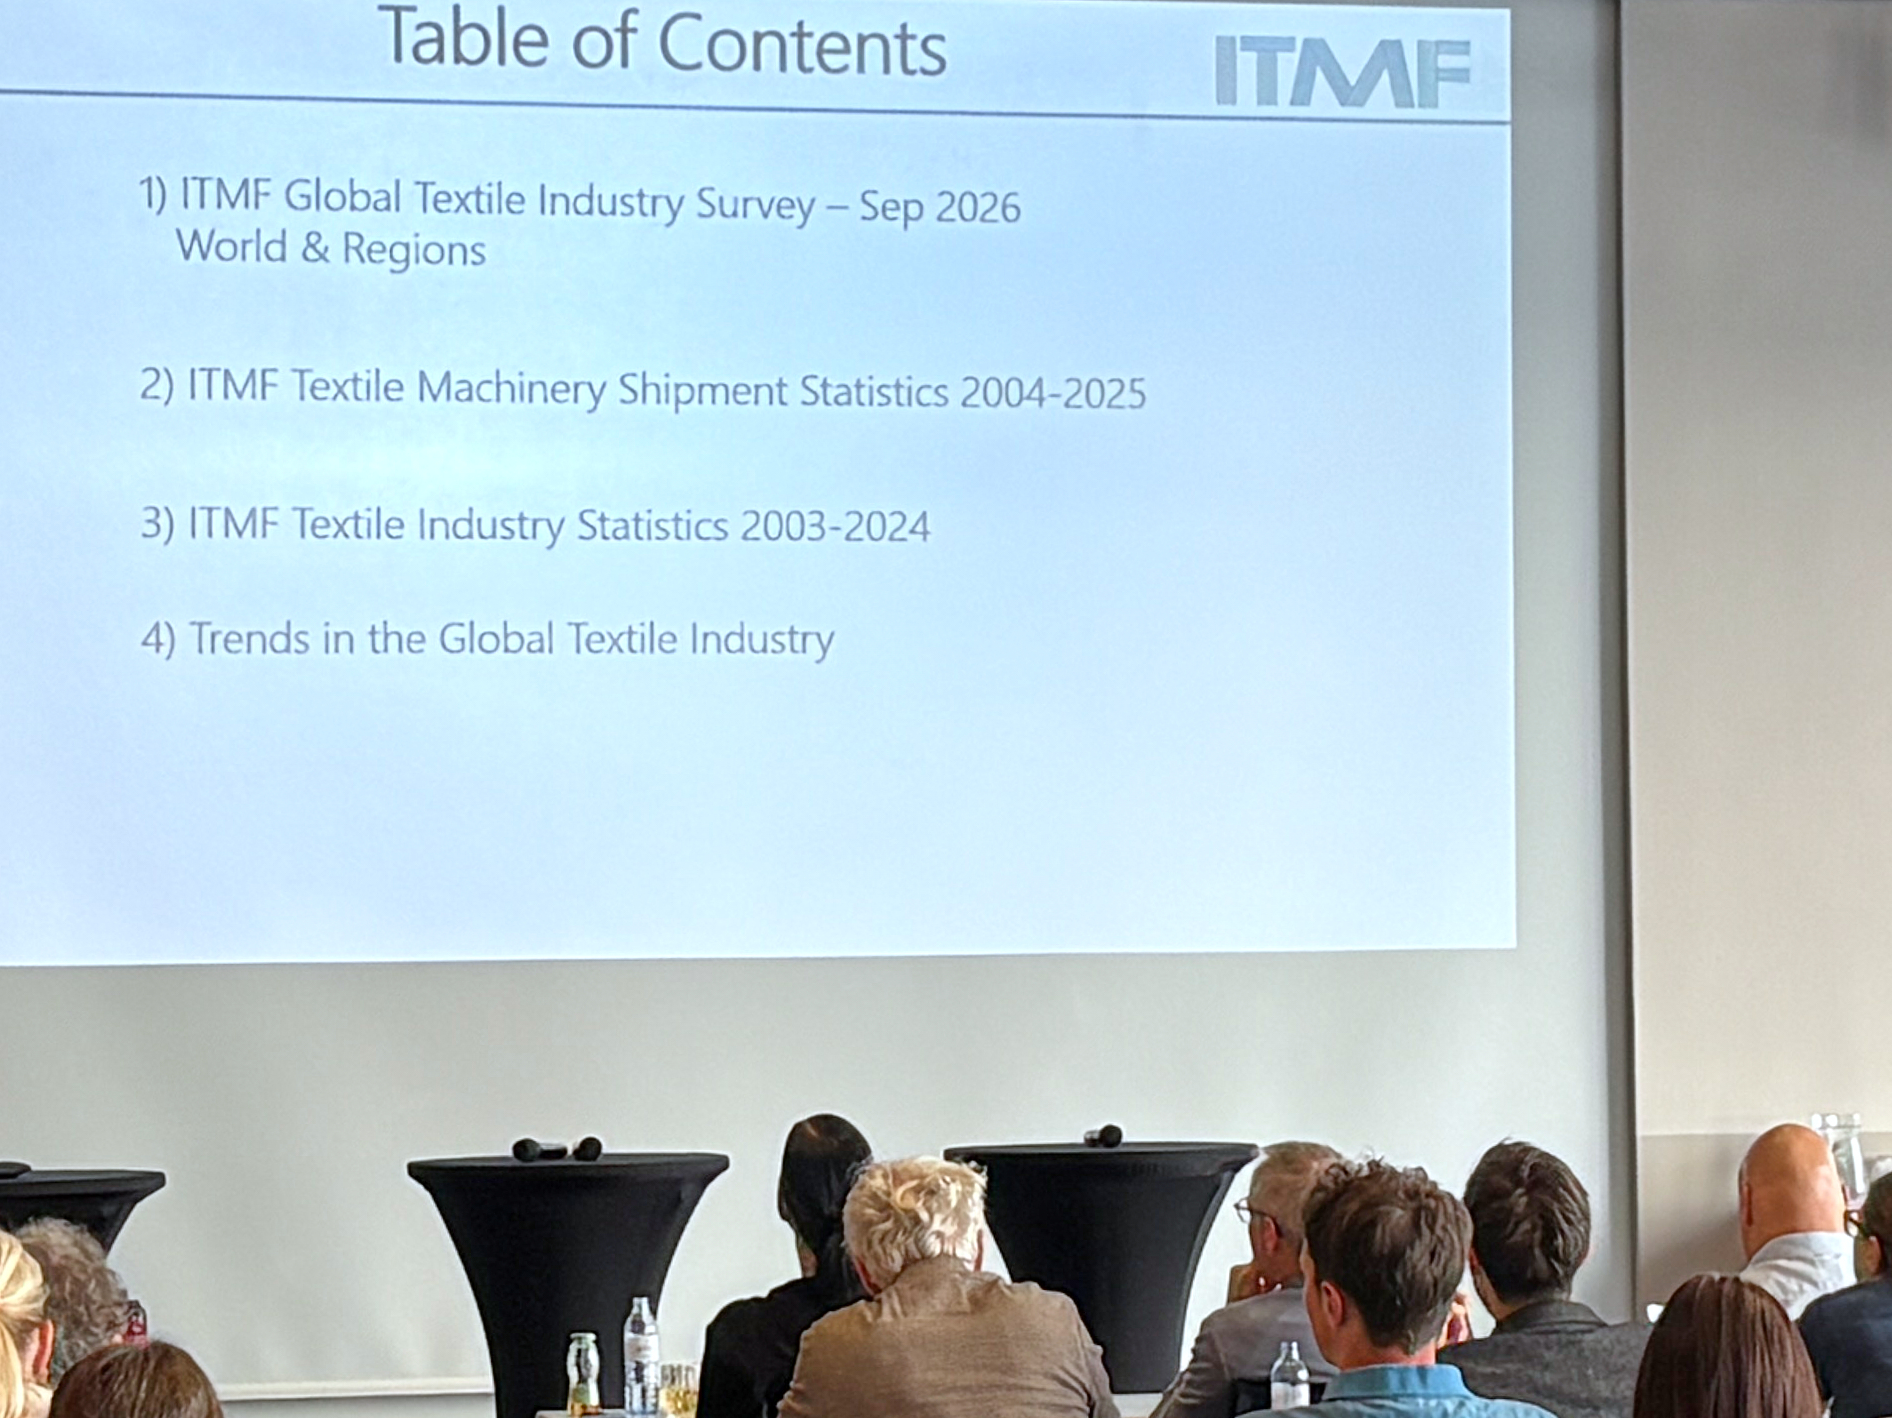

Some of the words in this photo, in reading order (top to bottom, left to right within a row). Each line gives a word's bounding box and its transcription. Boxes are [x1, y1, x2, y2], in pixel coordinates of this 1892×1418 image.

[377, 3, 549, 68] Table
[572, 7, 640, 69] of
[659, 11, 947, 77] Contents
[1215, 35, 1471, 110] ITMF
[139, 175, 167, 216] 1)
[182, 175, 272, 211] ITMF
[284, 176, 401, 213] Global
[414, 180, 526, 215] Textile
[539, 182, 685, 228] Industry
[697, 186, 816, 230] Survey
[860, 189, 924, 232] Sep
[936, 190, 1021, 223] 2026
[175, 227, 287, 263] World
[301, 230, 330, 264] &
[343, 230, 486, 275] Regions
[140, 366, 174, 407] 2)
[189, 367, 279, 401] ITMF
[290, 367, 405, 402] Textile
[418, 368, 607, 415] Machinery
[619, 370, 788, 415] Shipment
[800, 374, 949, 408] Statistics
[960, 375, 1147, 410] 2004-2025
[141, 505, 175, 546] 3)
[190, 505, 279, 540] ITMF
[291, 505, 405, 540] Textile
[419, 506, 566, 551] Industry
[577, 508, 729, 542] Statistics
[741, 509, 931, 542] 2003-2024
[140, 620, 176, 661] 4)
[189, 619, 310, 655] Trends
[323, 621, 354, 655] in
[367, 619, 427, 655] the
[439, 619, 554, 655] Global
[566, 620, 678, 655] Textile
[691, 620, 835, 665] Industry
